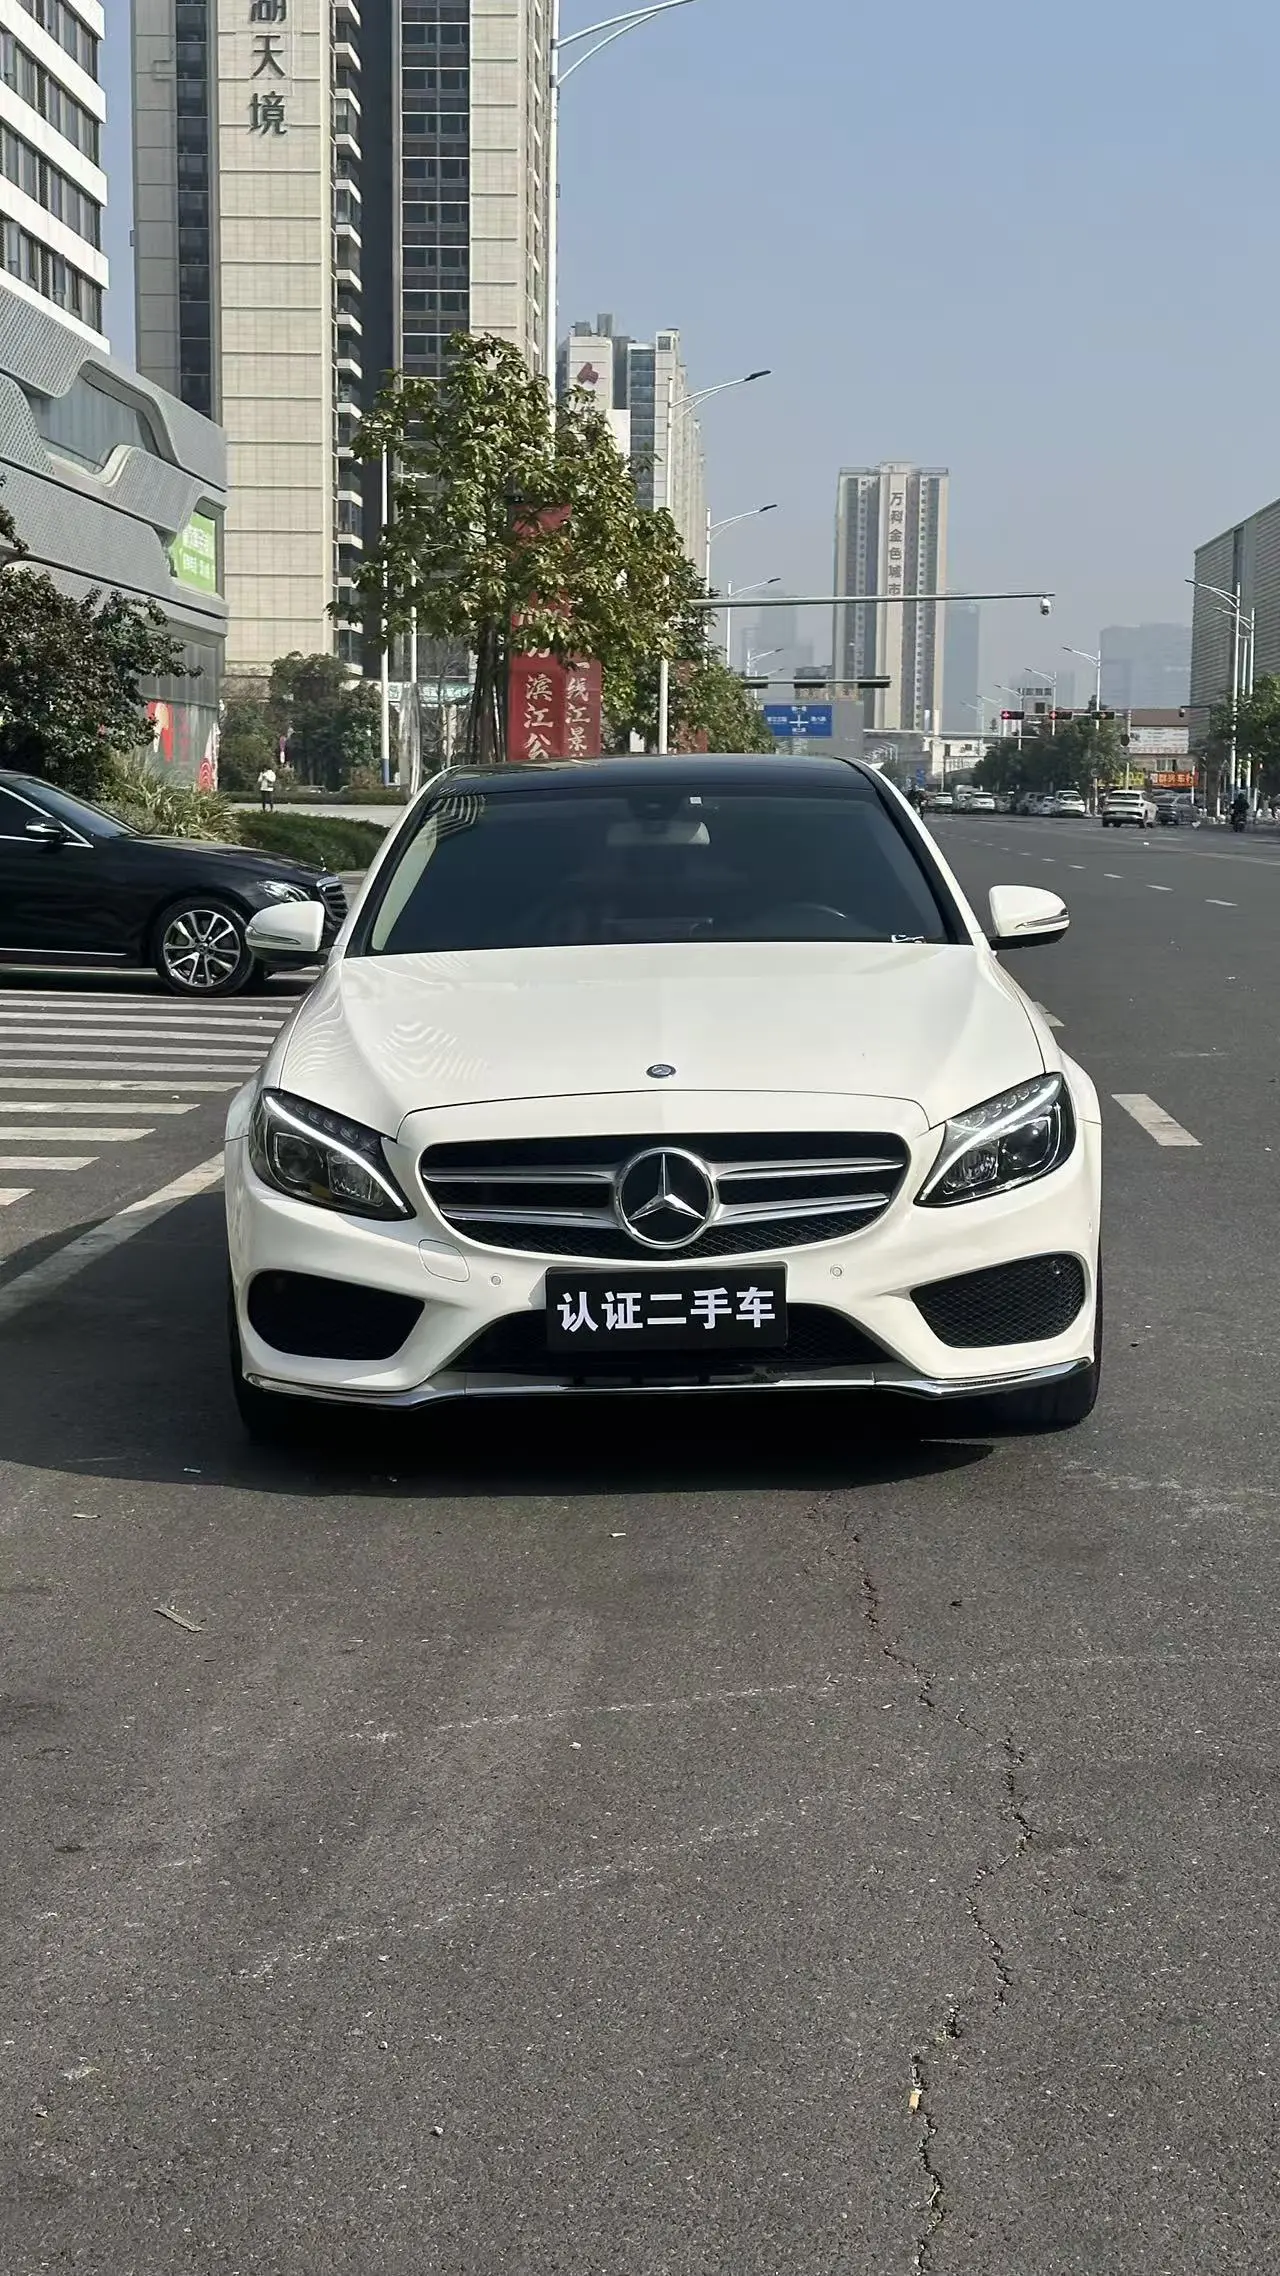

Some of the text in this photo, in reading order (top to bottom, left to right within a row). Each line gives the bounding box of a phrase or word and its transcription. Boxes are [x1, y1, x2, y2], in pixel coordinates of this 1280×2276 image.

[889, 491, 904, 596] 万科金色城市
[557, 1287, 776, 1333] 认证二手车
